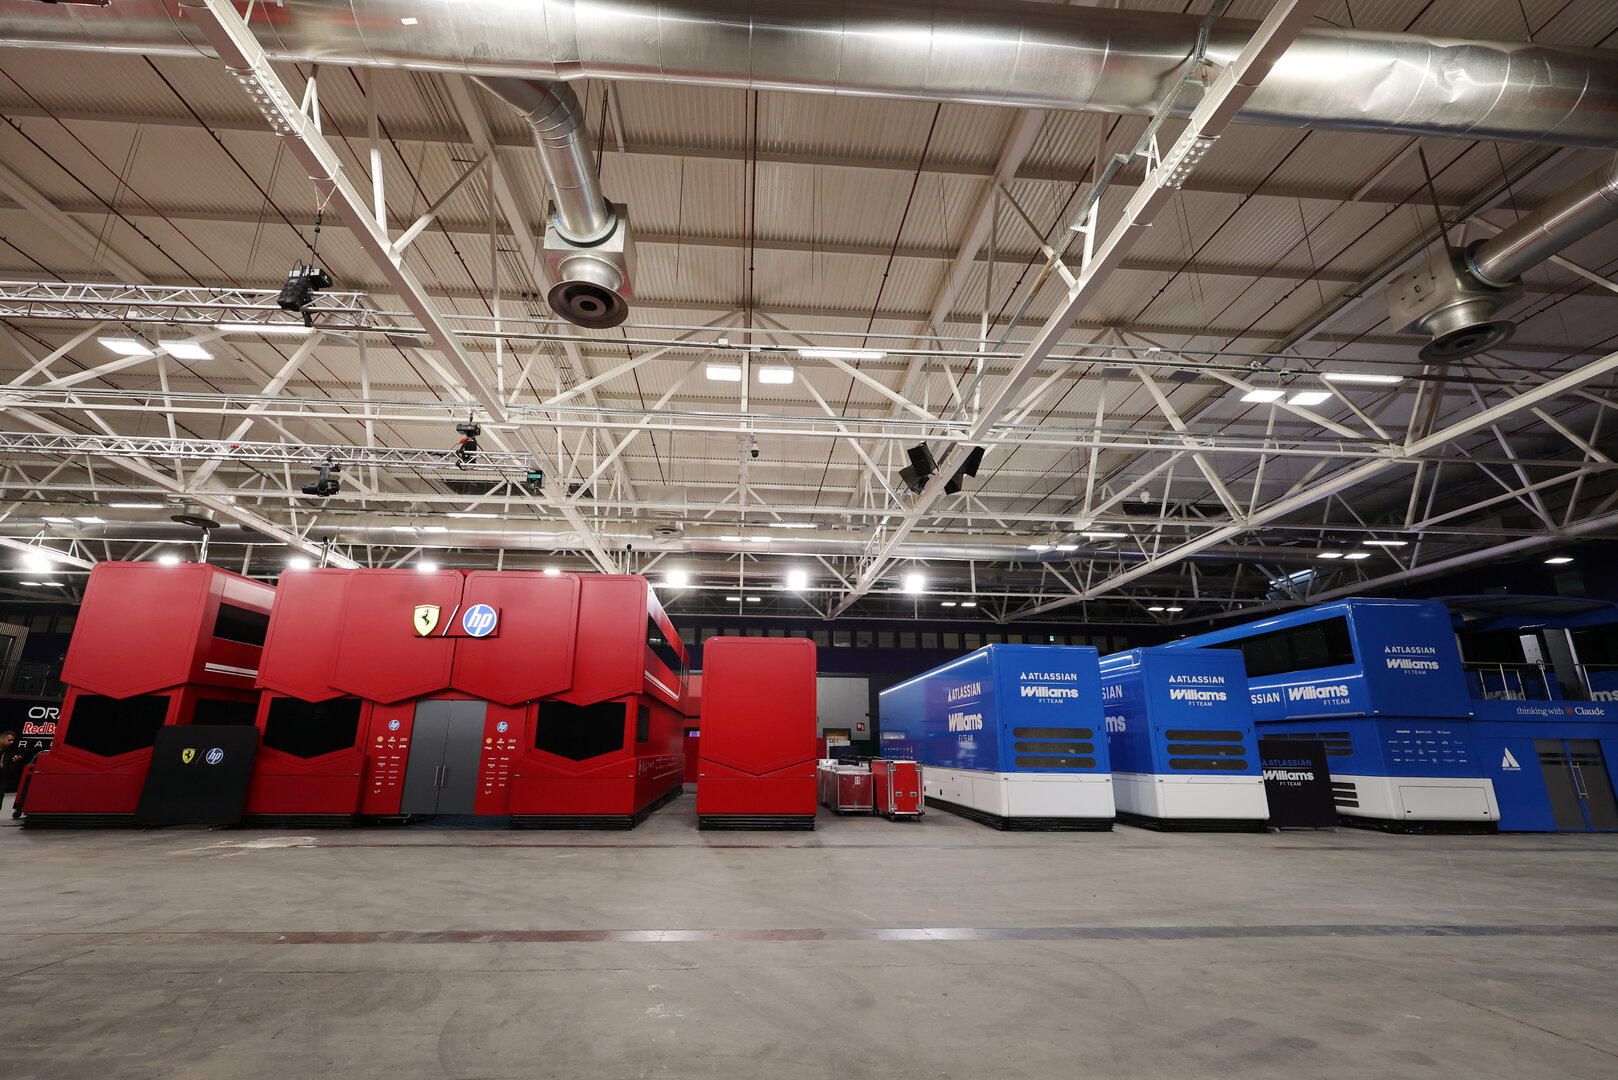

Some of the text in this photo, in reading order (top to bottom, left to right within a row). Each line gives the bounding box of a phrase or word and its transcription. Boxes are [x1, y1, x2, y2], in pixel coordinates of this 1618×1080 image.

[464, 604, 496, 637] hp
[1392, 646, 1436, 654] ATLASSIAN
[1386, 658, 1439, 670] Williams
[1028, 672, 1077, 680] ATLASSIAN
[1176, 675, 1225, 684] ATLASSIAN
[951, 681, 981, 701] ATLASSIAN
[1020, 686, 1079, 698] Williams
[1169, 688, 1228, 701] Williams
[1288, 685, 1349, 701] Williams
[28, 706, 60, 719] OR
[1516, 706, 1606, 717] thinking with Claude
[22, 721, 57, 735] Red B
[948, 712, 983, 732] Williams
[18, 740, 53, 748] RA
[206, 747, 224, 765] hp
[1269, 759, 1312, 767] ATLASSIAN
[1262, 769, 1315, 781] Williams
